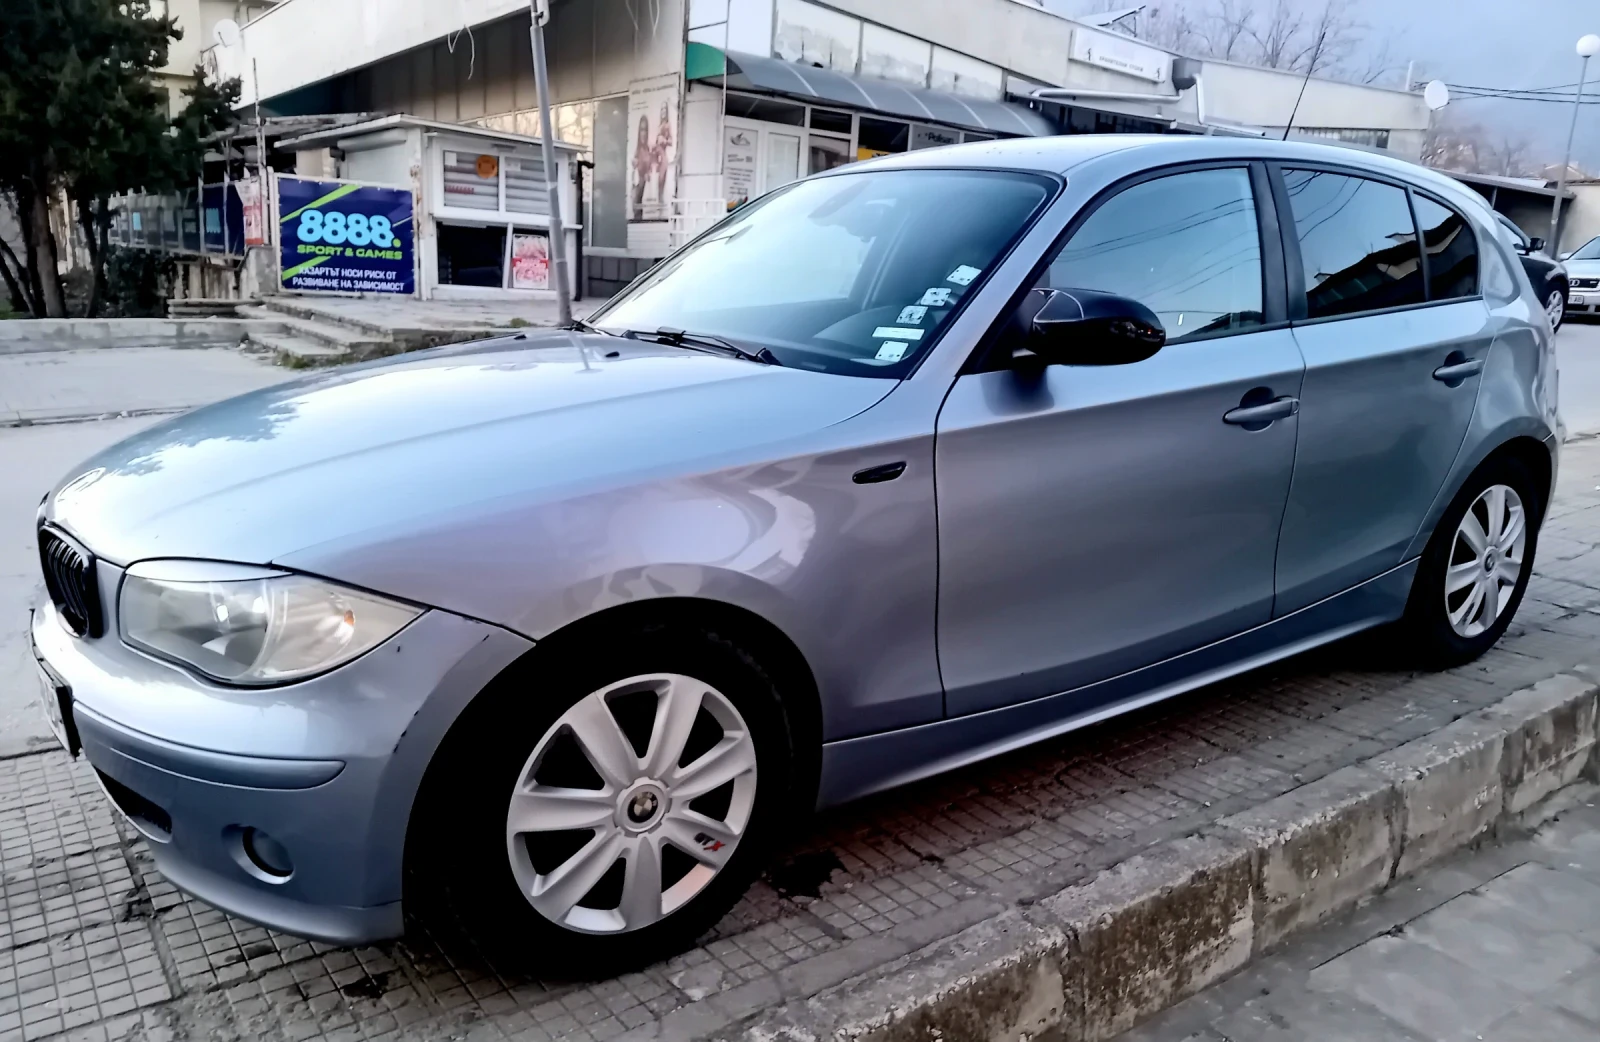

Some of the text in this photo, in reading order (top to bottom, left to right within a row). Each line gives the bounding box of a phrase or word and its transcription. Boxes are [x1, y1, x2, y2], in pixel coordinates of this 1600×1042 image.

[297, 244, 403, 260] SPORT & GAMES
[341, 268, 364, 278] НОСИ
[364, 270, 386, 280] РИСК
[386, 271, 397, 280] ОТ
[292, 276, 405, 291] РАЗВИВАНЕ НА ЗАВИСИМОСТ
